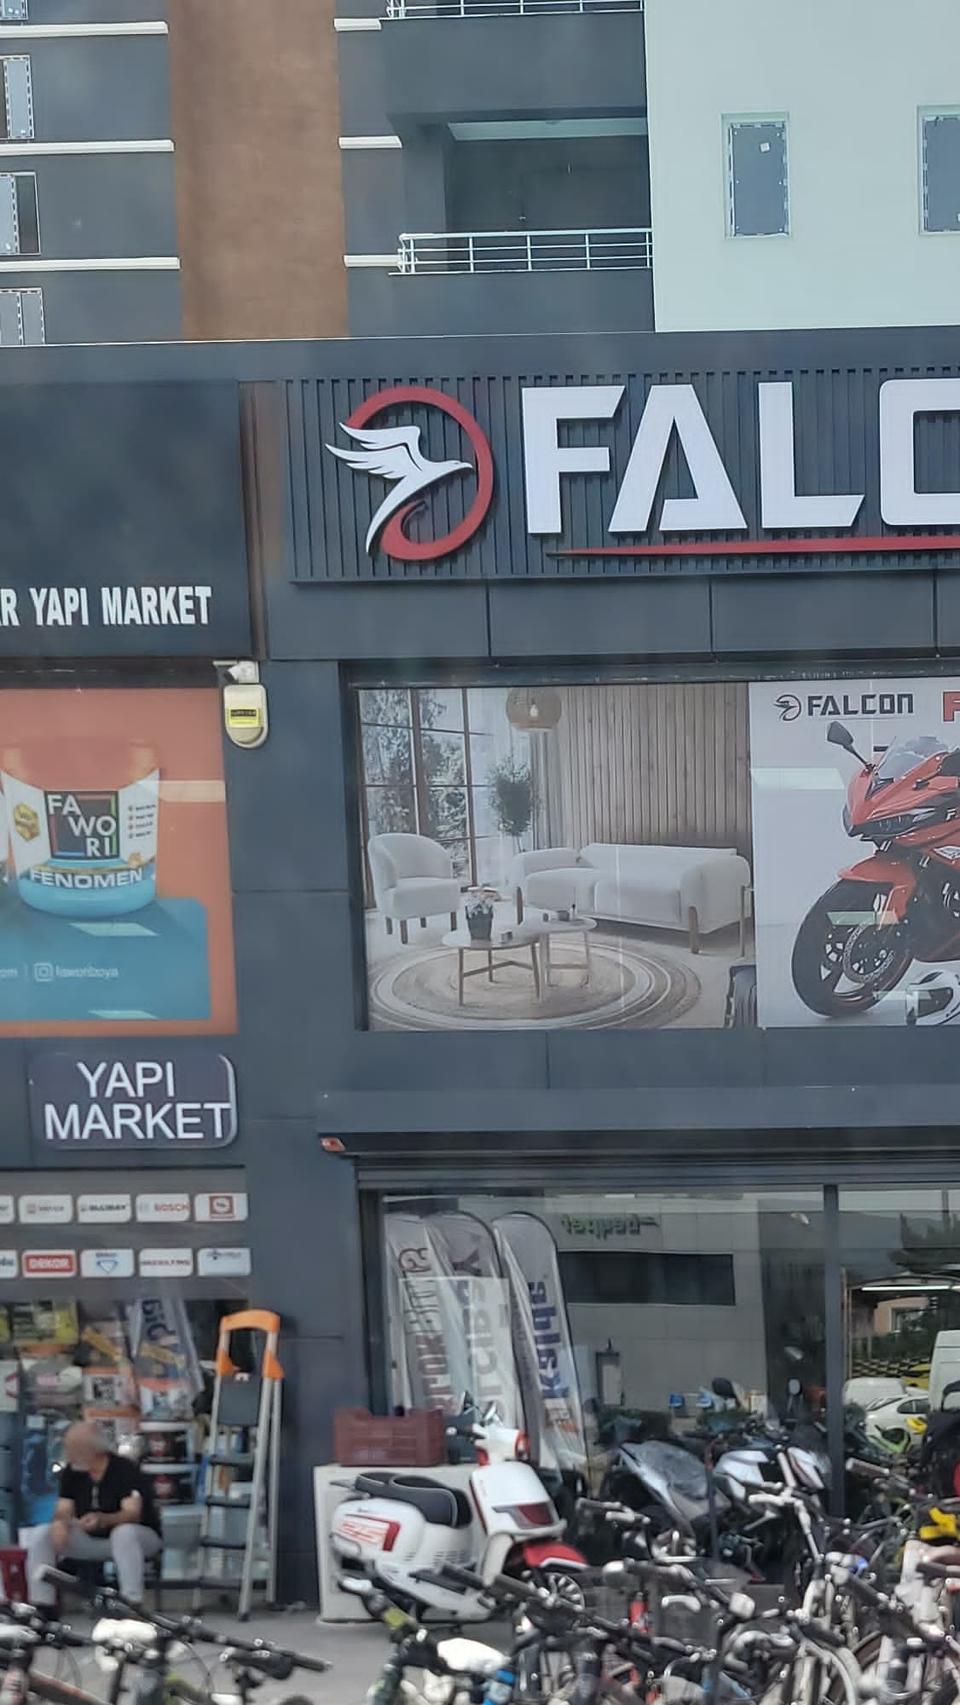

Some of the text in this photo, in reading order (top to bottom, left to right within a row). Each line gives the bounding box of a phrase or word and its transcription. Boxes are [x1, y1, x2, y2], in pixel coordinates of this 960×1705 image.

[29, 587, 89, 626] YAPI
[101, 586, 212, 625] MARKET
[807, 693, 914, 717] FALCON
[47, 794, 82, 816] FA
[68, 816, 117, 837] WO
[86, 838, 111, 857] RI
[30, 868, 142, 889] FENOMEN
[76, 1061, 175, 1098] YAPI
[44, 1102, 232, 1140] MARKET
